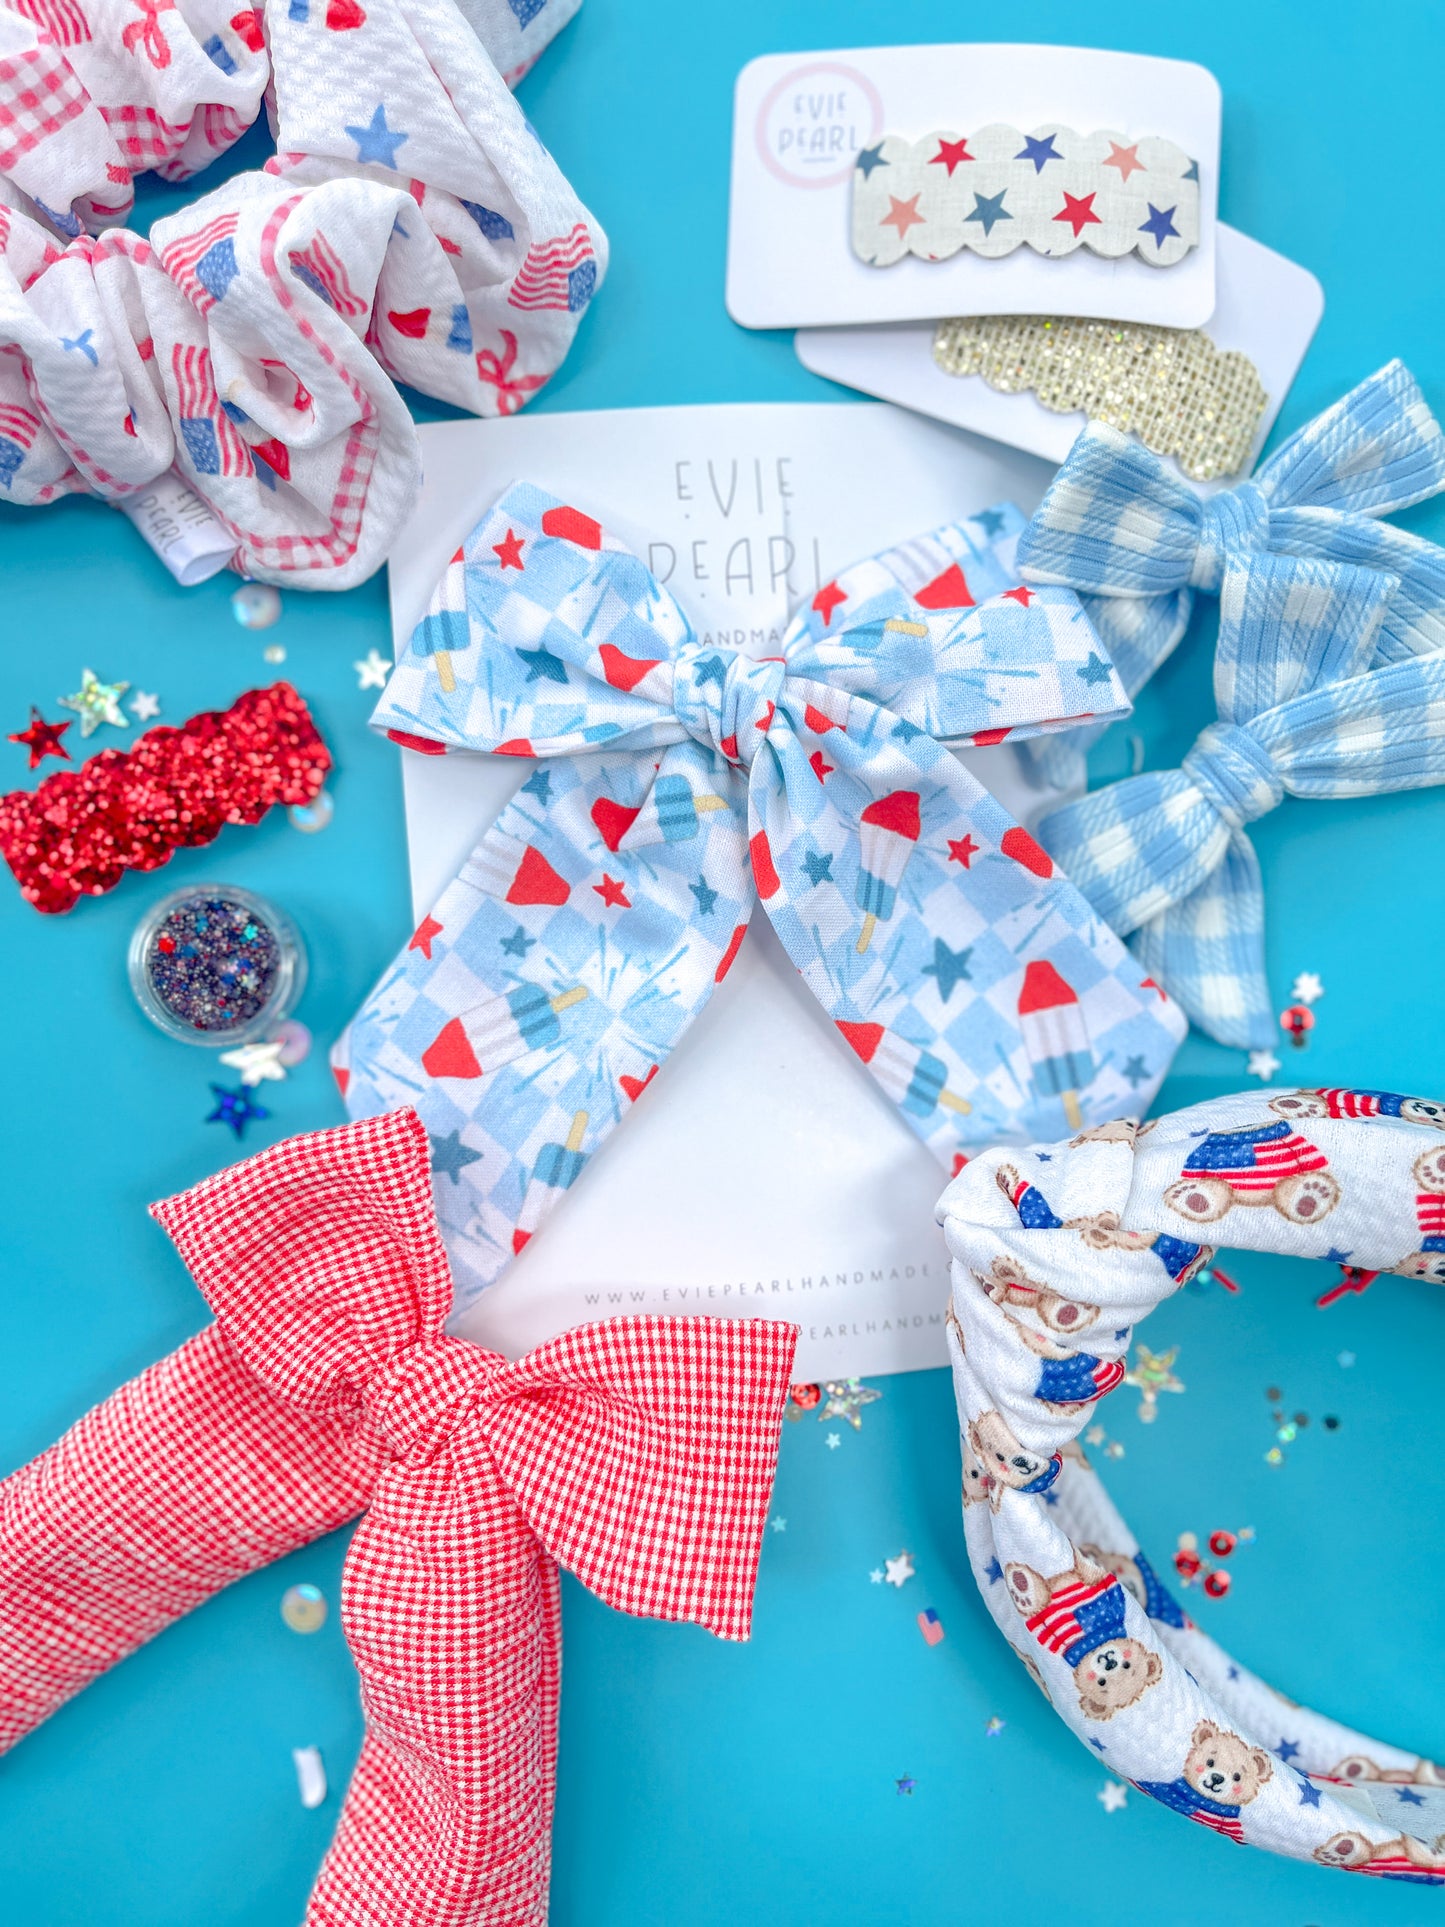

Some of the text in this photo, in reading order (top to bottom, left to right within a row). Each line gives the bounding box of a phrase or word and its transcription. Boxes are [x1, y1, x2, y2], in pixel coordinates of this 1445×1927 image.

[793, 91, 847, 121] EVIE
[778, 124, 858, 154] PEARL
[675, 457, 794, 519] EVIE
[135, 495, 184, 554] PEARL
[171, 489, 213, 529] EVIE
[703, 626, 787, 646] ANDMA
[796, 1309, 949, 1340] EARLHANDM
